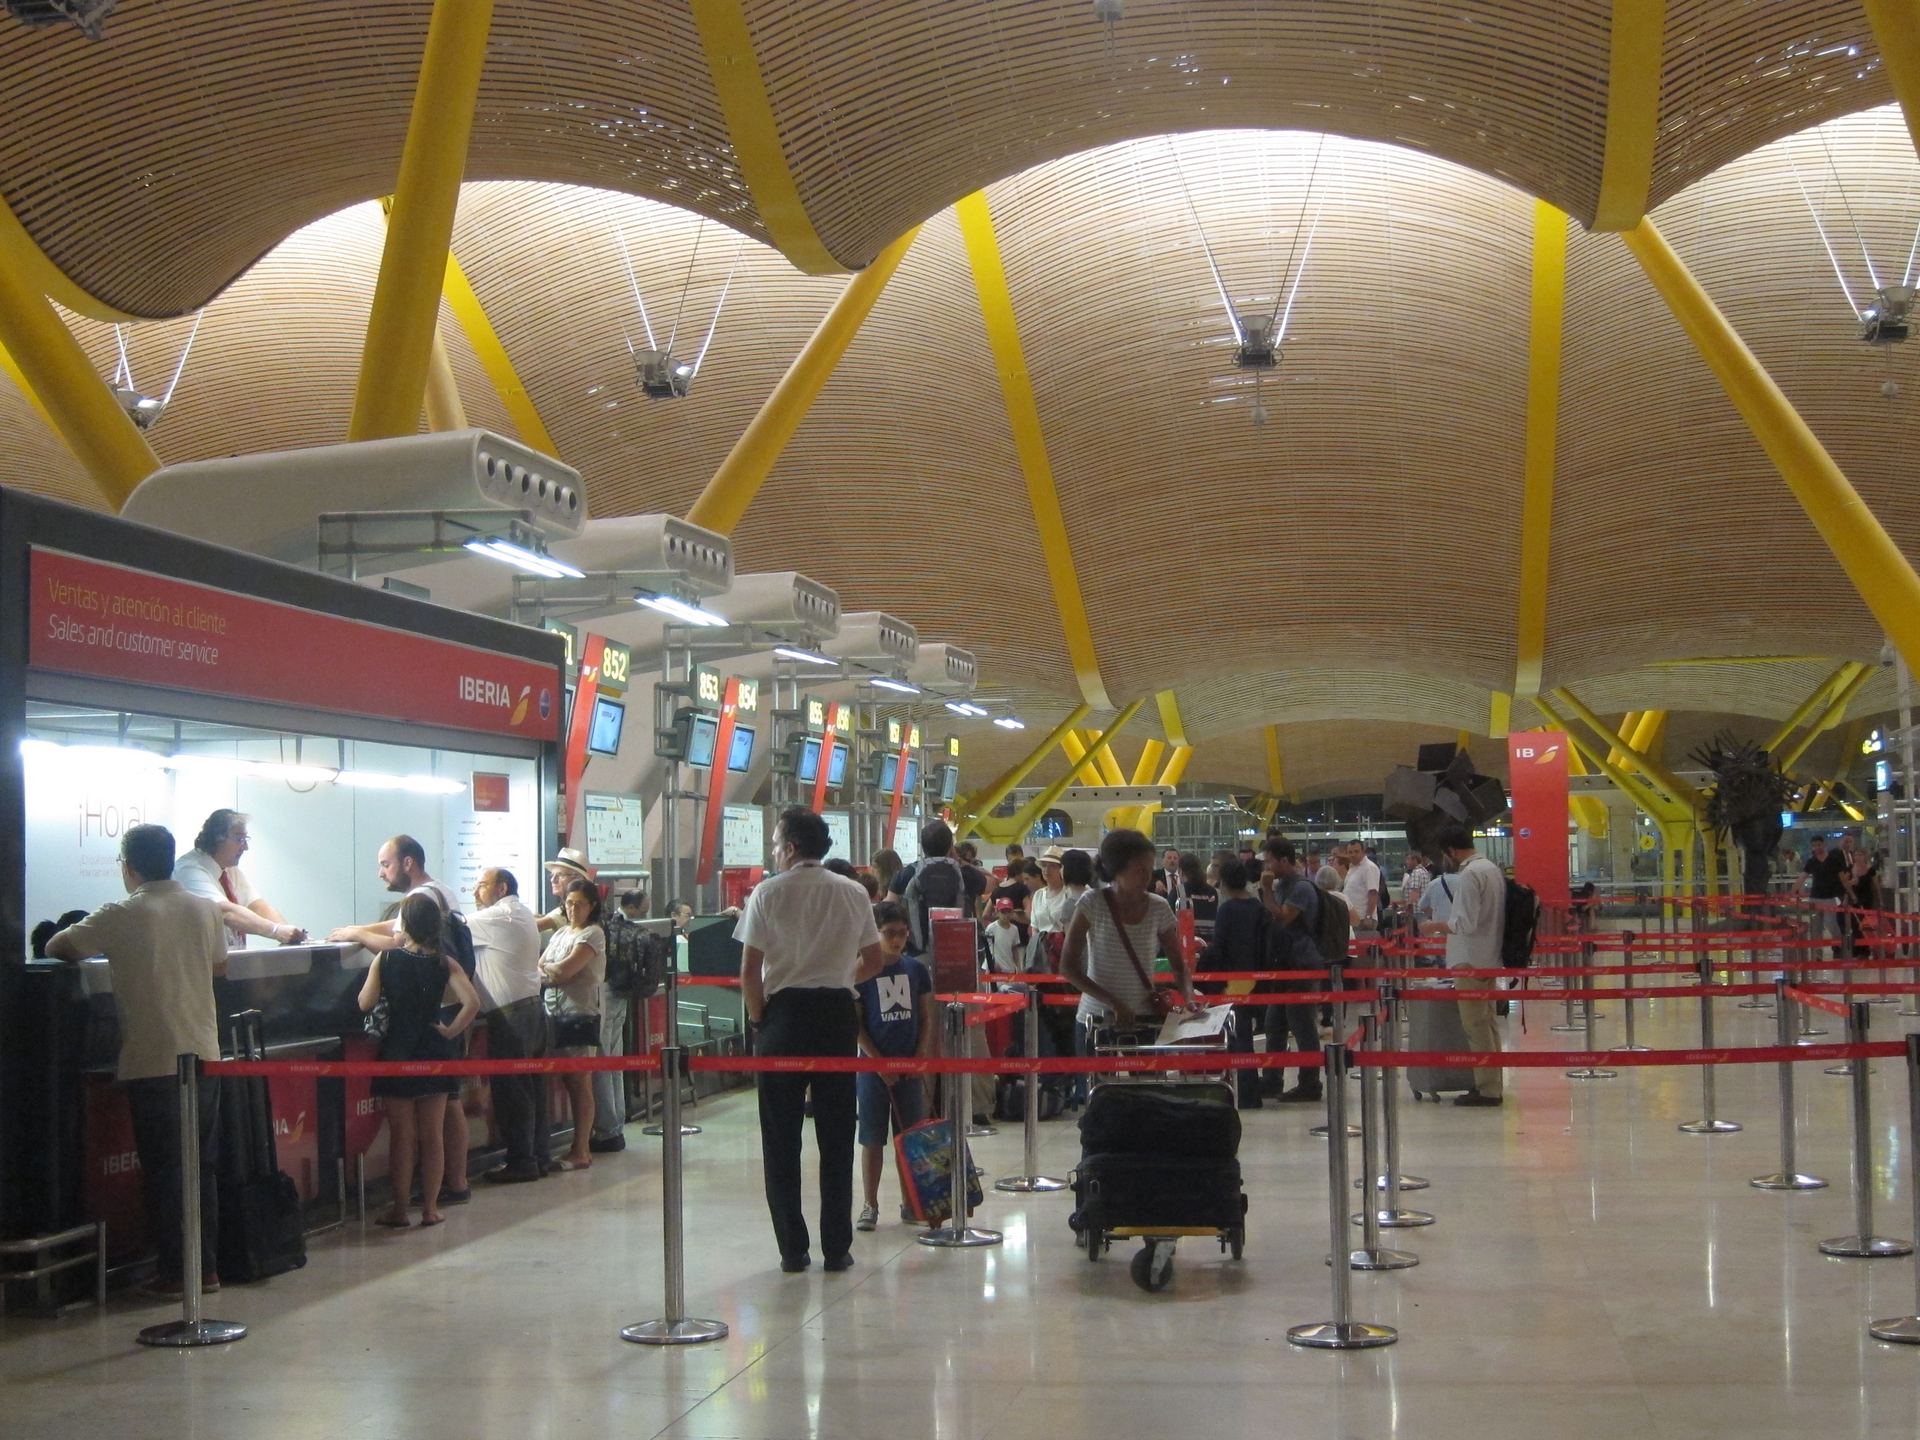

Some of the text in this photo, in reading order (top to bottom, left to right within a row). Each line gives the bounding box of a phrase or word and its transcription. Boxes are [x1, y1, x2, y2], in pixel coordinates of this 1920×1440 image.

[48, 577, 227, 635] Ventas y atención al cliente
[48, 613, 219, 665] Sales and customer service
[603, 647, 626, 683] 852
[459, 675, 511, 708] IBERIA
[700, 672, 718, 701] 853
[738, 683, 756, 711] 854
[1516, 748, 1534, 758] IB
[356, 1096, 384, 1116] IBER
[103, 1151, 142, 1176] IBER
